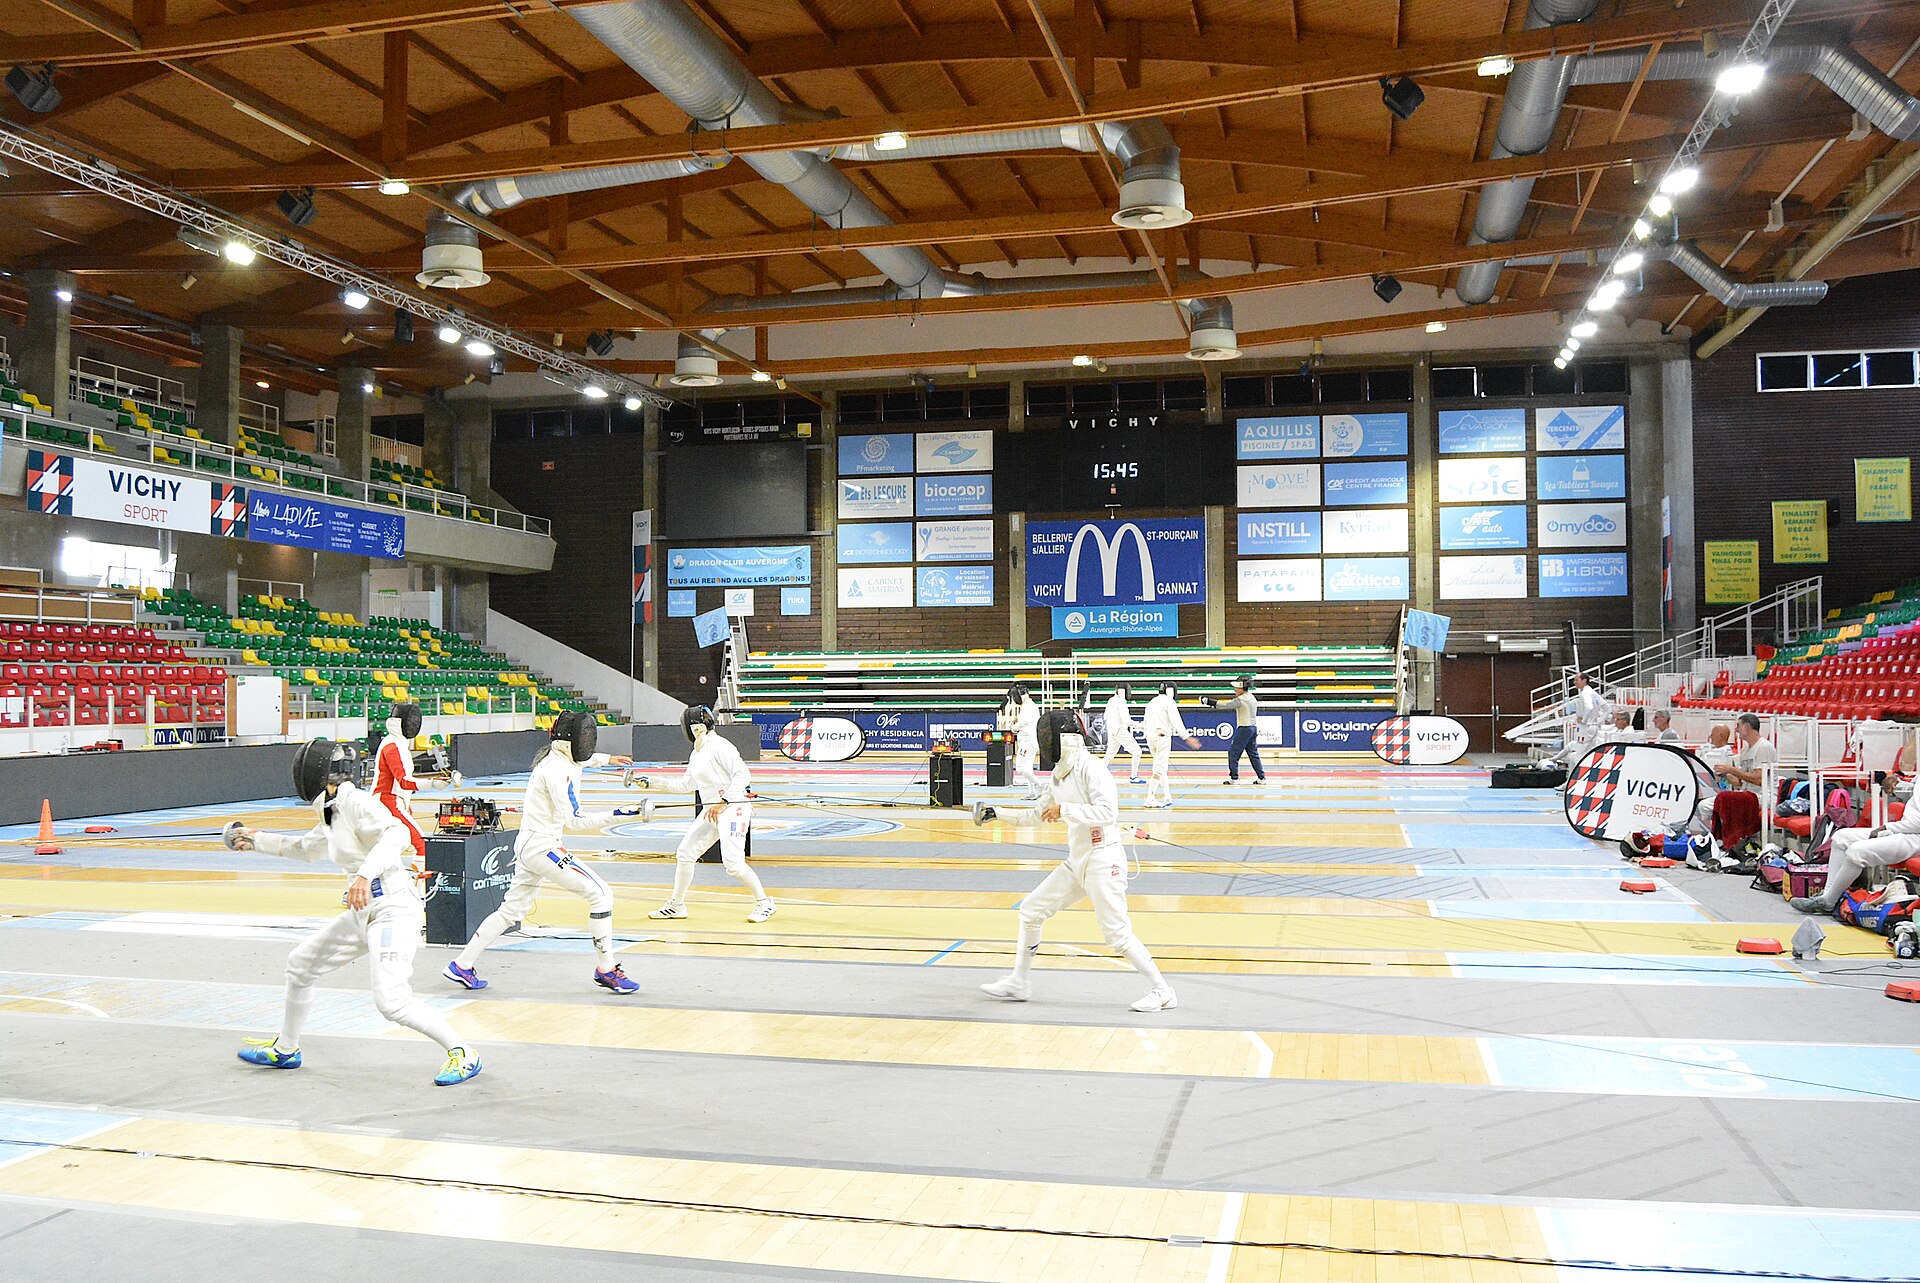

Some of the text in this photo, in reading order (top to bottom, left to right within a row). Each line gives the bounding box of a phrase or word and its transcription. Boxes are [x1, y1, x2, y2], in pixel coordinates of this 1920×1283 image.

[1069, 417, 1158, 429] VICHY
[1244, 424, 1312, 438] AQUILUS
[1243, 442, 1281, 450] PISCINES
[1290, 441, 1313, 449] SPAS
[856, 465, 895, 473] PFmarketing
[1093, 463, 1138, 479] 15:45
[109, 469, 182, 502] VICHY
[924, 482, 986, 500] biocoop
[1448, 480, 1520, 496] SPIE
[1557, 481, 1588, 490] Tabliers
[873, 484, 907, 500] LESCURE
[124, 504, 167, 523] SPORT
[272, 503, 323, 528] LADVIE
[962, 525, 991, 533] plomberie
[1247, 522, 1311, 538] INSTILL
[1482, 524, 1503, 533] auto
[1032, 534, 1073, 543] BELLERIVE
[1146, 531, 1199, 541] ST-POURÇAIN
[1032, 545, 1065, 555] s/ALLIER
[1566, 566, 1624, 576] H.BRUN
[963, 588, 991, 596] réception
[1033, 585, 1062, 597] VICHY
[1157, 582, 1198, 594] GANNAT
[1089, 611, 1163, 625] La Région
[1090, 625, 1163, 634] Auvergne-Rhône-Alpes
[1322, 721, 1376, 731] boulan
[818, 732, 854, 740] VICHY
[1323, 733, 1349, 741] Vichy
[1417, 733, 1460, 741] VICHY
[1626, 778, 1686, 802] VICHY
[1632, 804, 1669, 819] SPORT
[558, 854, 573, 869] FRA
